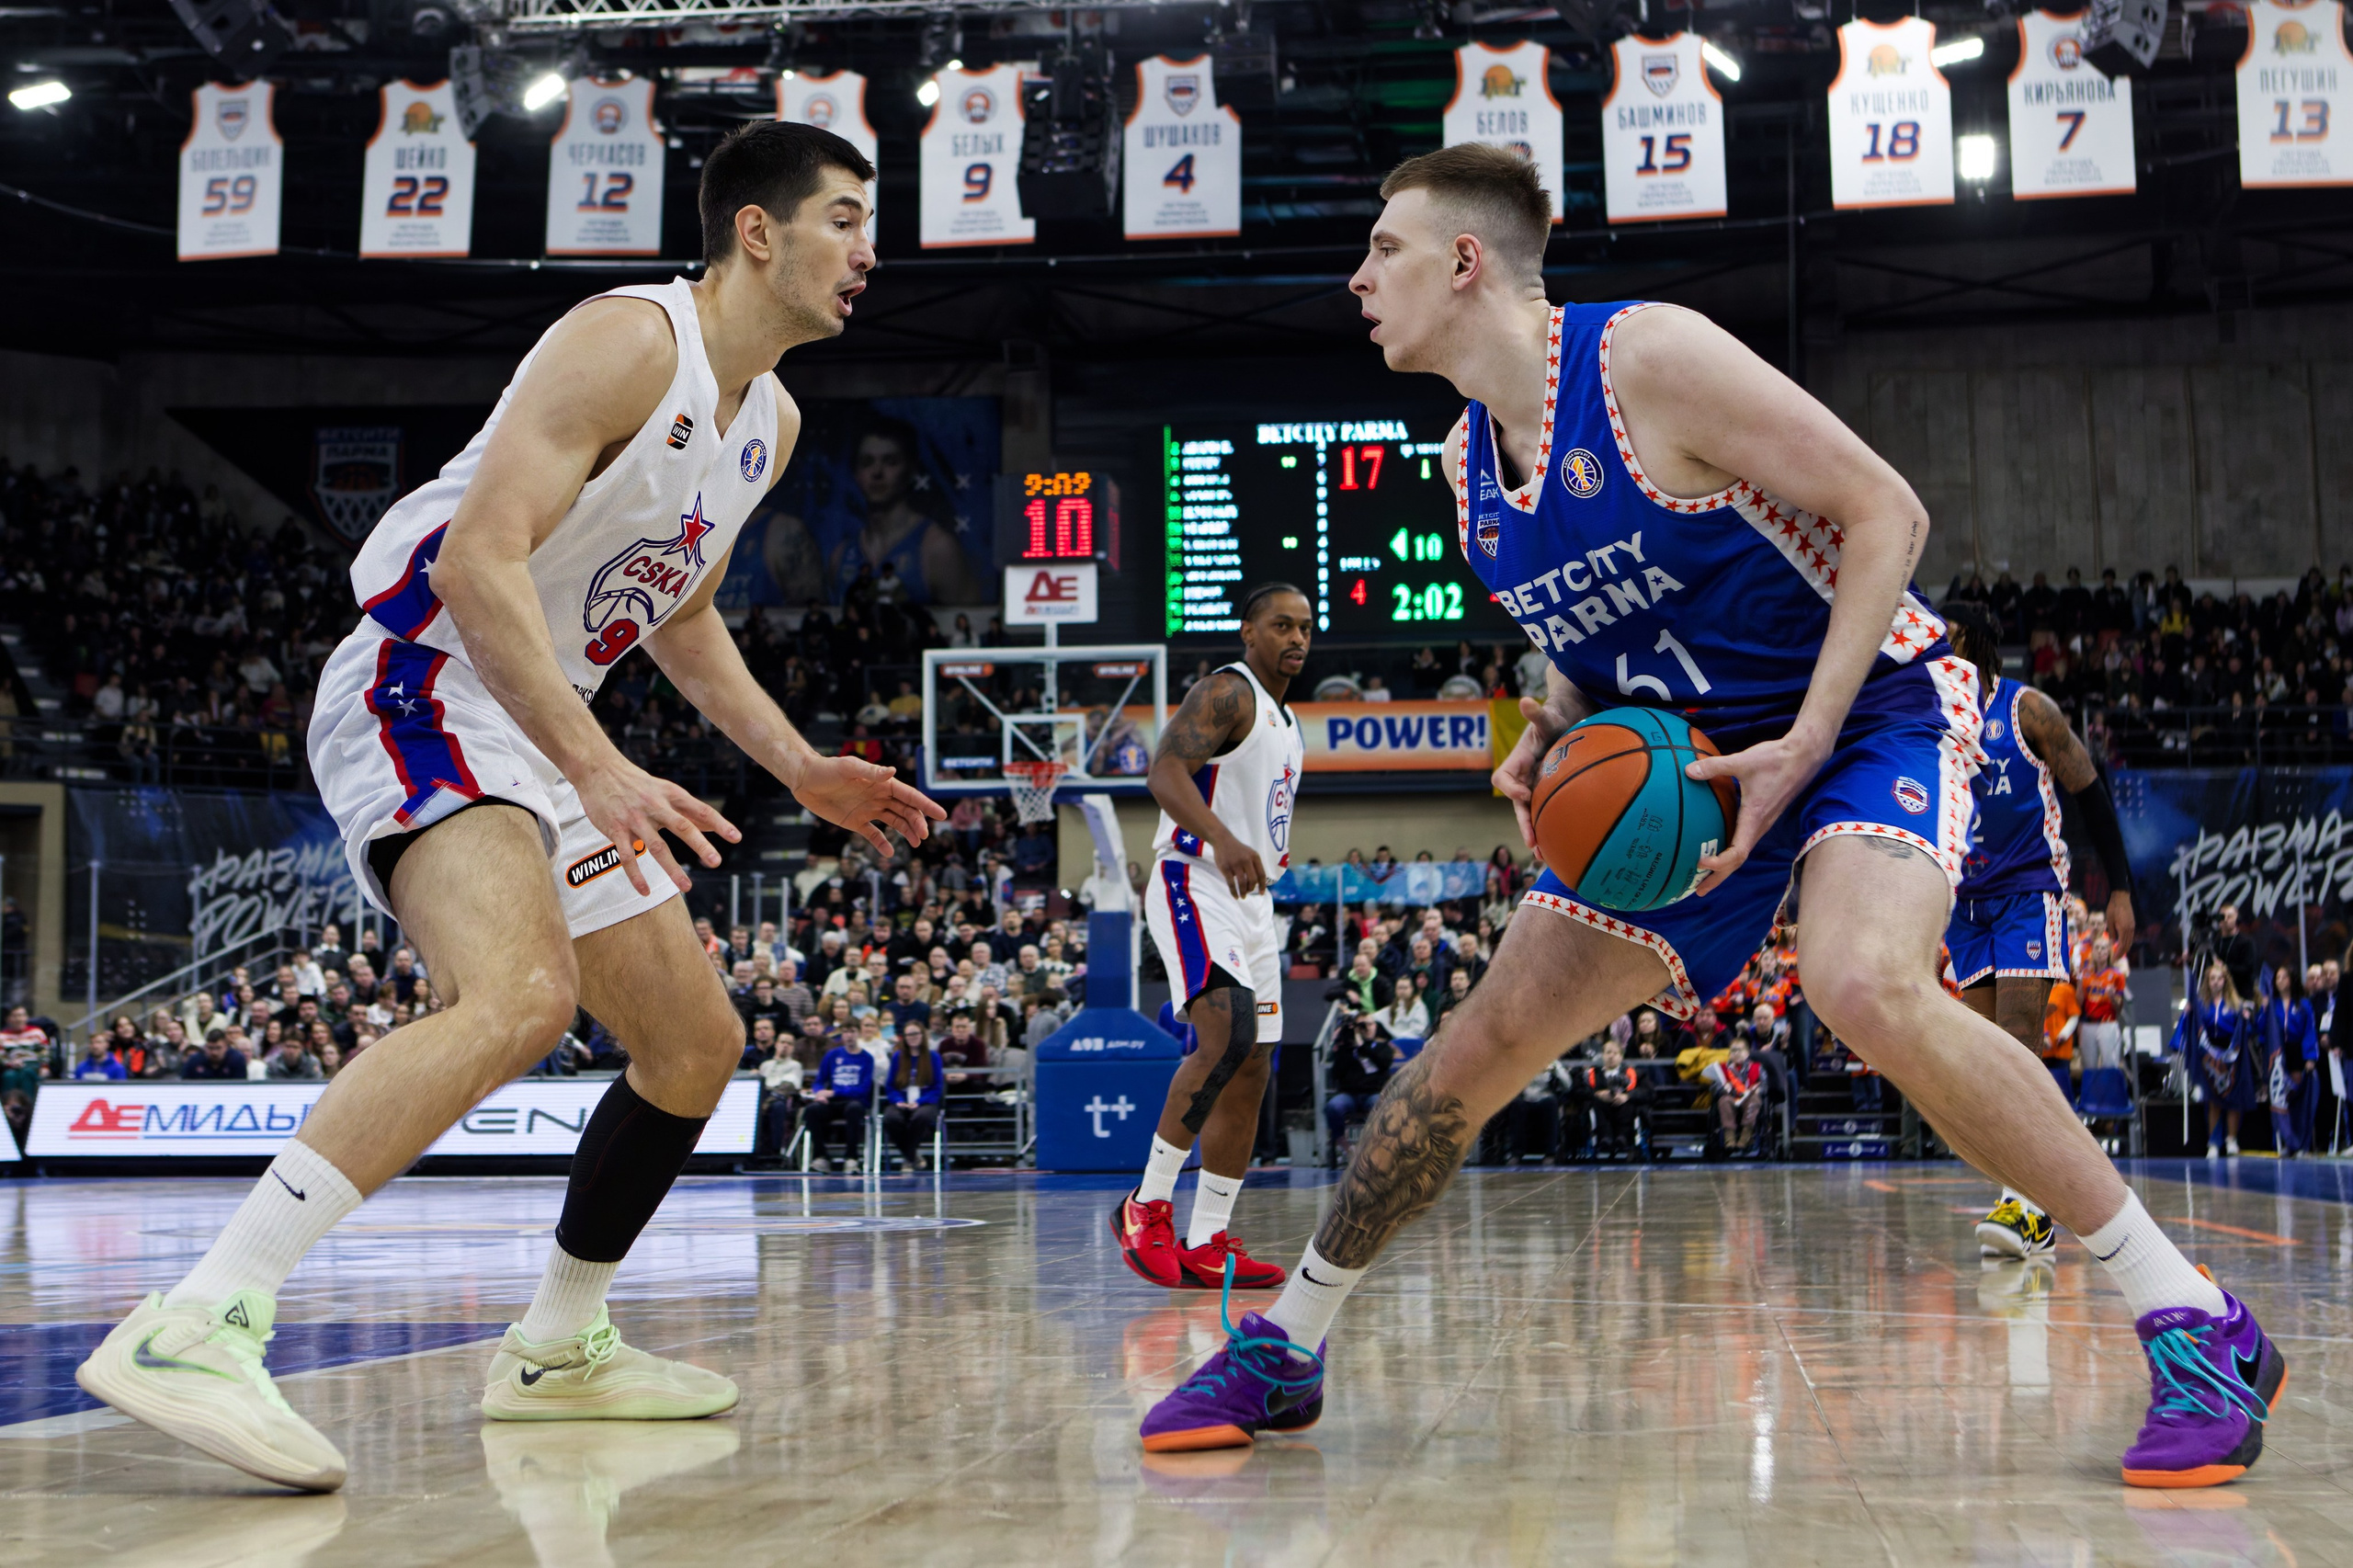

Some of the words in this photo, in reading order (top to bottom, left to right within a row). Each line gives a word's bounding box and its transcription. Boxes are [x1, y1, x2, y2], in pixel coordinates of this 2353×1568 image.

[2260, 67, 2337, 94] ПЕГУШИН
[1618, 101, 1707, 131] БАШМИНОВ
[1851, 89, 1928, 115] КУЩЕНКО
[2270, 98, 2331, 145] 13
[1476, 110, 1528, 135] БЕЛОВ
[1862, 120, 1920, 165] 18
[2056, 110, 2086, 153] 7
[395, 142, 447, 170] ШЕЙКО
[569, 143, 645, 165] ЧЕРКАСОВ
[952, 133, 1005, 157] БЕЛЫХ
[1636, 133, 1692, 176] 15
[576, 171, 634, 212] 12
[962, 163, 993, 204] 9
[1163, 153, 1196, 194] 4
[201, 175, 257, 217] 59
[386, 176, 449, 217] 22
[672, 425, 689, 439] WIN
[1339, 446, 1385, 490] 17
[1480, 487, 1499, 501] EAK
[1022, 497, 1092, 558] 10
[1415, 532, 1443, 561] 10
[622, 555, 690, 599] CSKA
[1350, 578, 1367, 606] 4
[1495, 530, 1646, 618] BETCITY
[1392, 582, 1464, 621] 2:02
[1520, 565, 1686, 654] PARMA
[585, 618, 640, 665] 9
[1327, 714, 1486, 751] POWER!
[572, 847, 620, 883] WINLIN
[70, 1098, 314, 1131] ДЕМИДЫ
